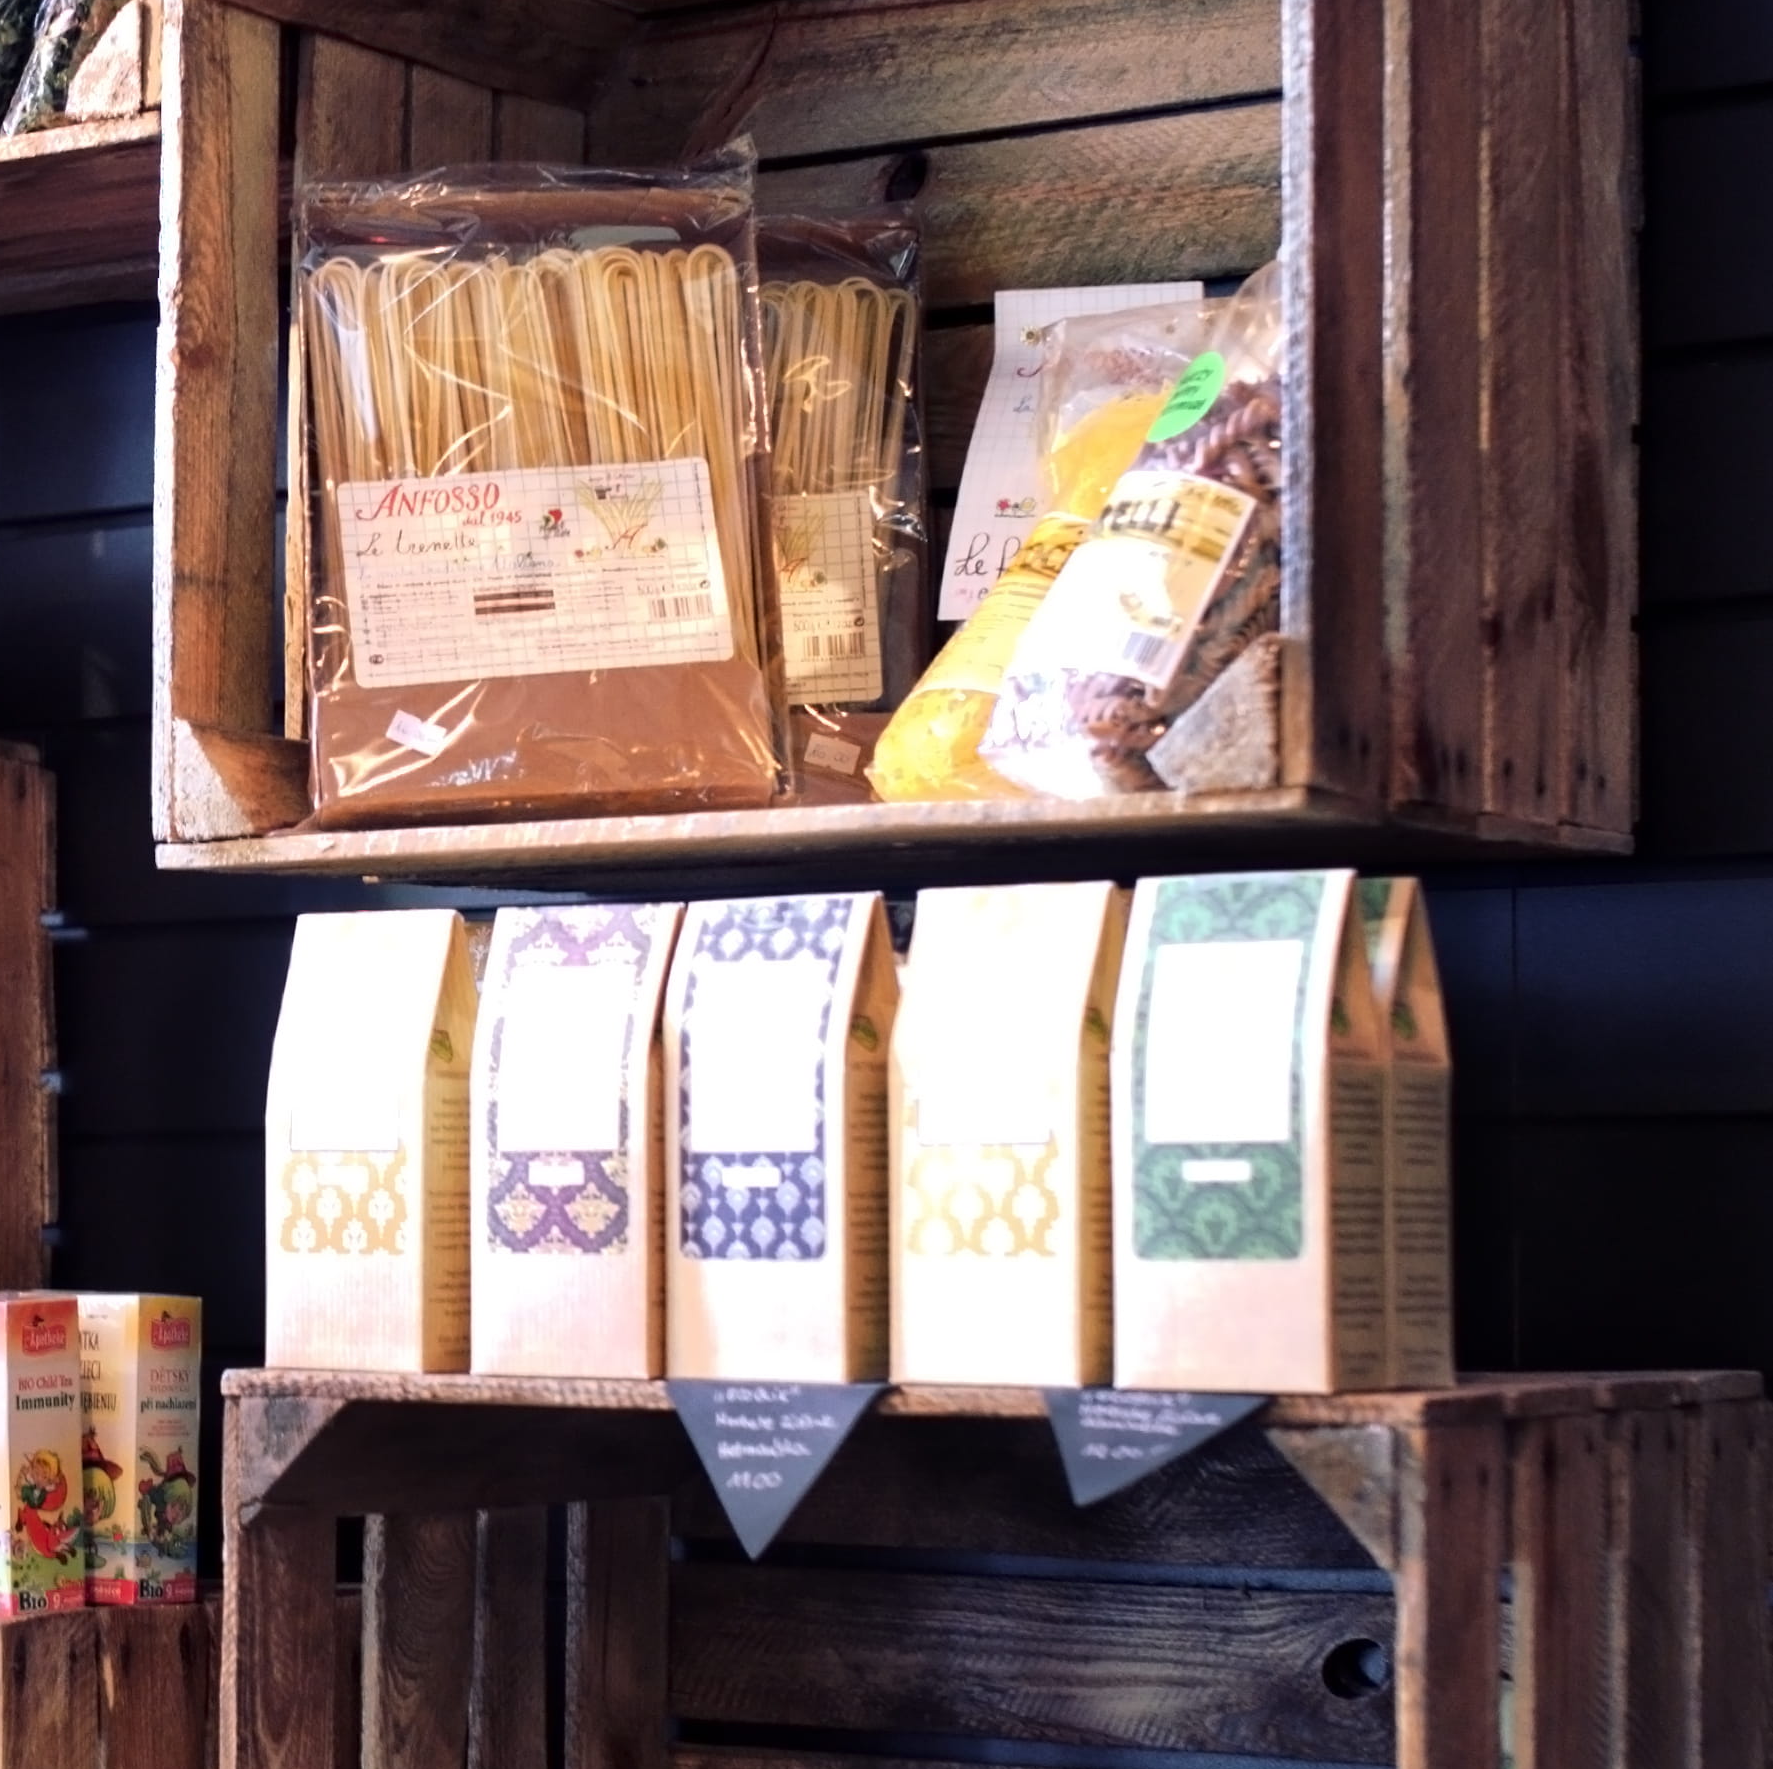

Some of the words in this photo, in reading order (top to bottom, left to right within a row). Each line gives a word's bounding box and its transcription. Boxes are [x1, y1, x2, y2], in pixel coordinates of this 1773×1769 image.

[356, 482, 500, 521] ANFOSSO
[490, 510, 523, 525] 1945
[16, 1392, 76, 1412] Immunity
[139, 1579, 164, 1599] Bio
[19, 1590, 47, 1610] Bio
